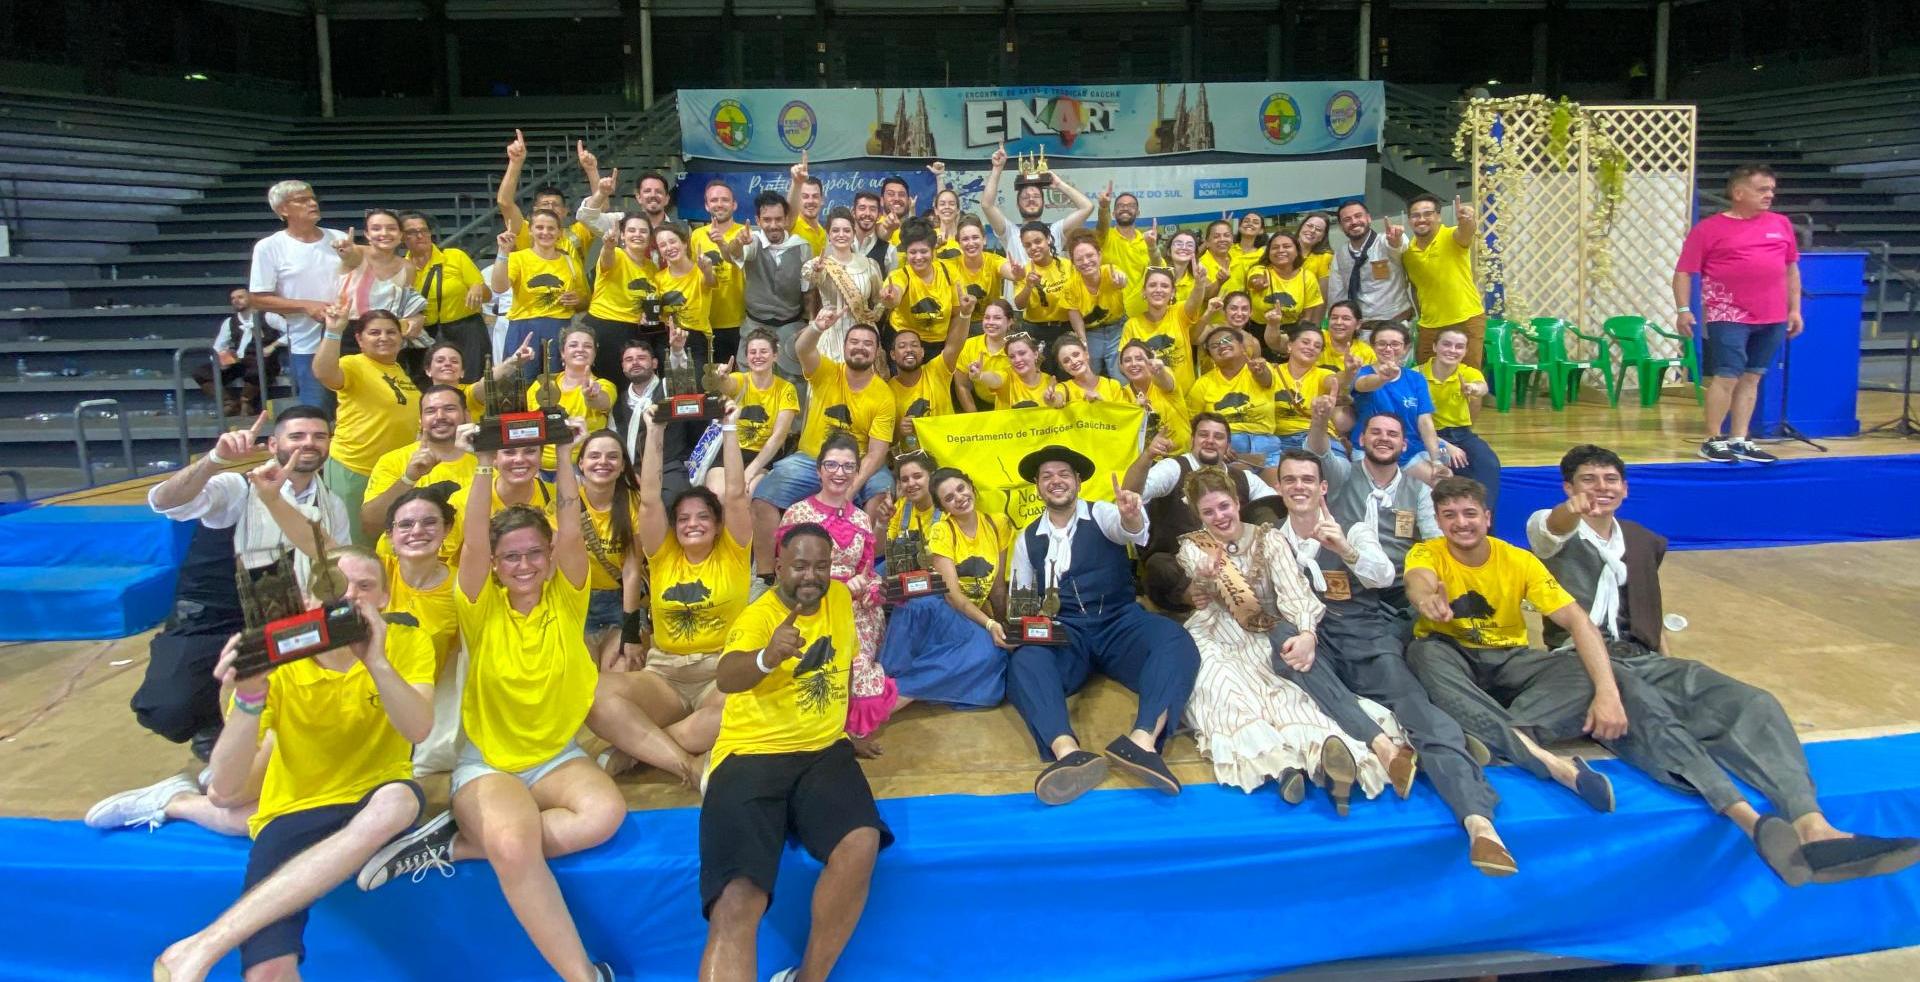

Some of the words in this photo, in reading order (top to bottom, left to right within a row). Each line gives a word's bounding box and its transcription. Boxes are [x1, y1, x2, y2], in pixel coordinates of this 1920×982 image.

[965, 97, 1120, 147] ENART
[1147, 190, 1162, 199] DO
[1164, 189, 1183, 198] SUL
[946, 431, 1013, 444] Departamento
[1015, 429, 1027, 438] de
